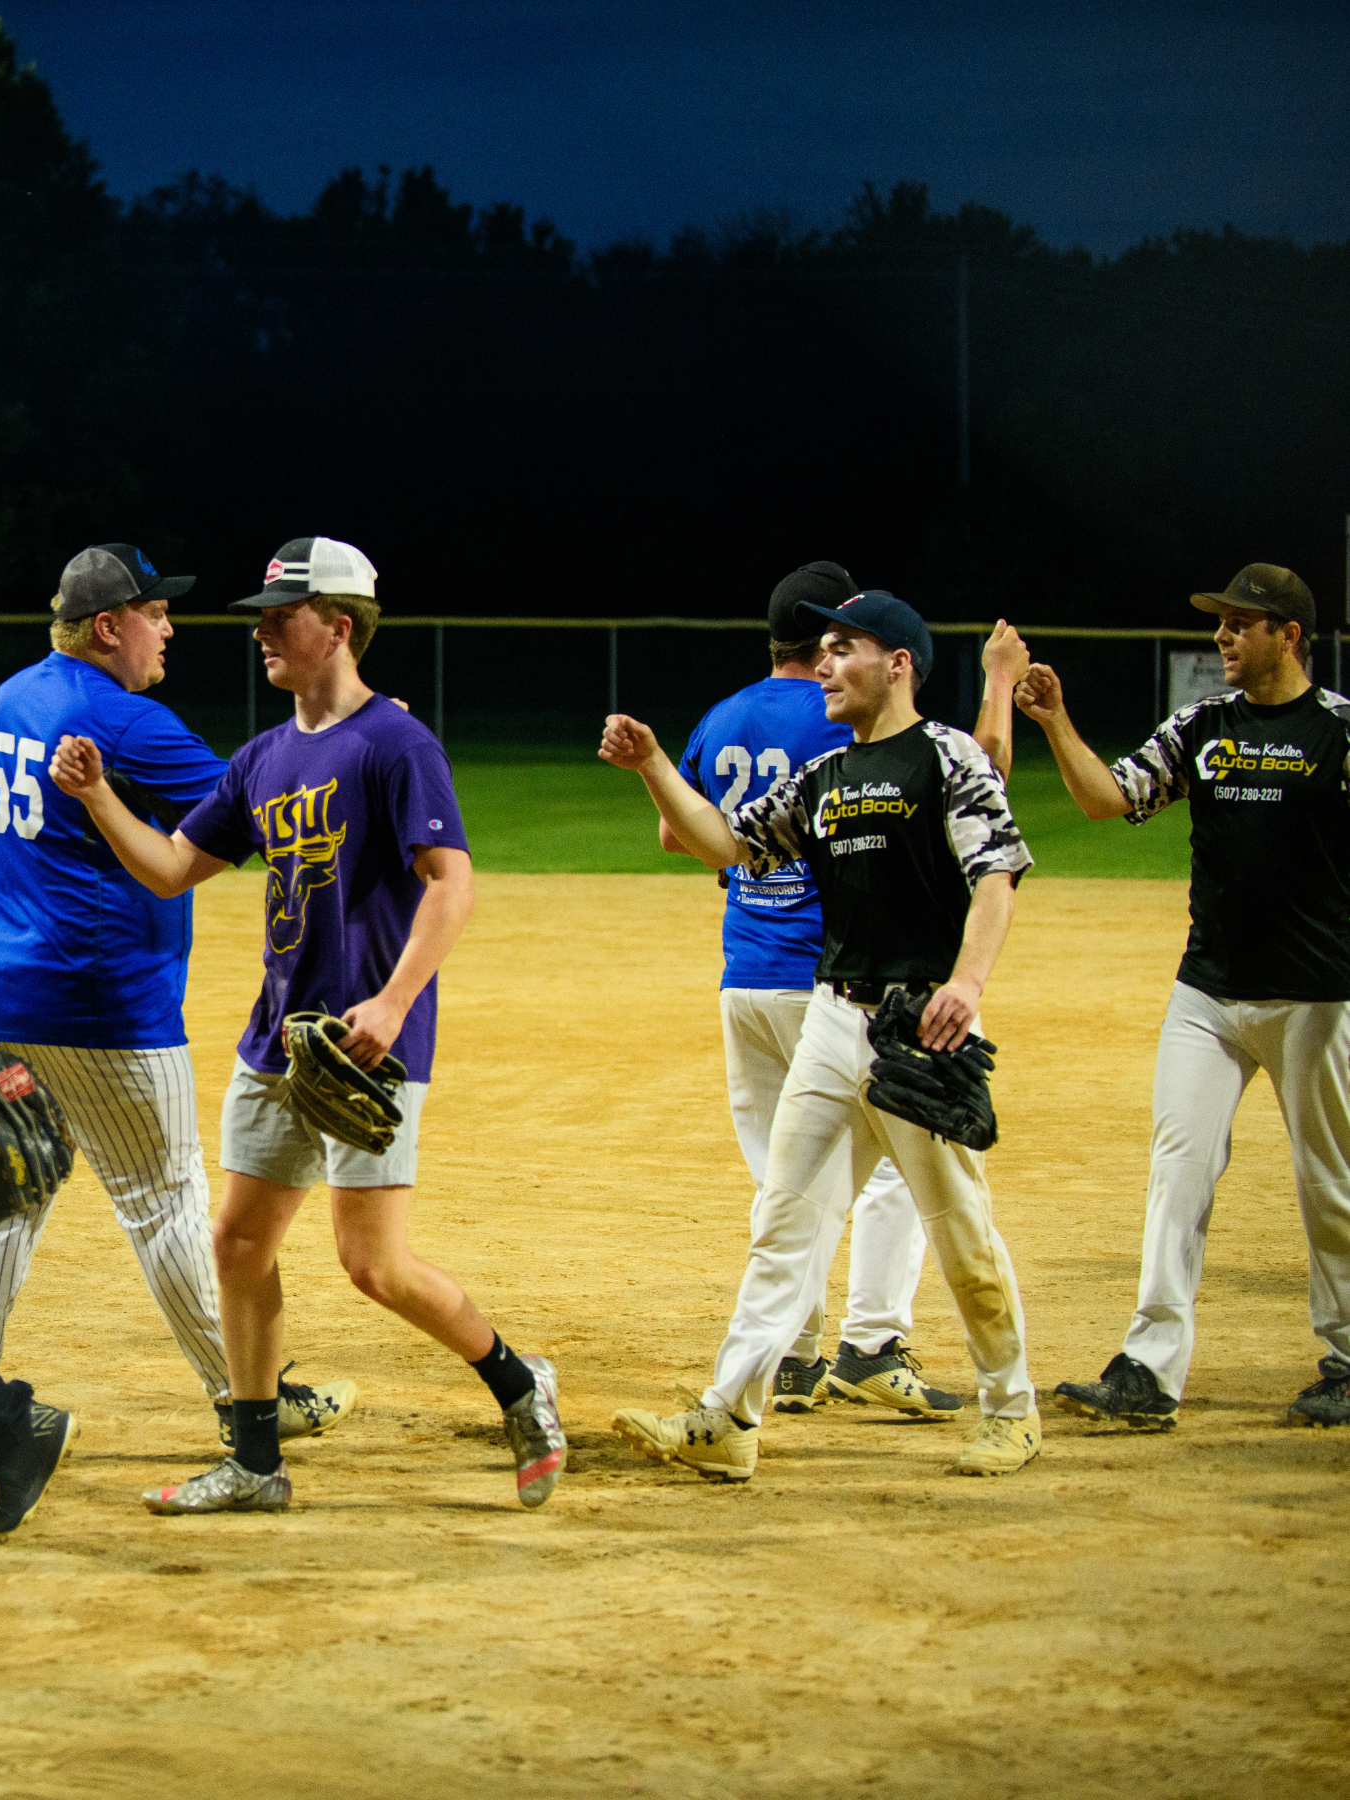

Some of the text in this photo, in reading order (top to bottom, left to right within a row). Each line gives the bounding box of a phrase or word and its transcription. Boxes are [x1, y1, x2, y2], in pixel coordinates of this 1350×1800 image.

[1238, 741, 1303, 758] Tom Kadlec
[1208, 754, 1318, 776] Auto Body
[715, 745, 790, 814] 22
[842, 782, 902, 801] Tom Kadlec
[1214, 785, 1283, 801] (507) 280-2221
[821, 798, 919, 823] Auto Body
[830, 839, 852, 857] (507)
[739, 882, 806, 896] WATERWORKS
